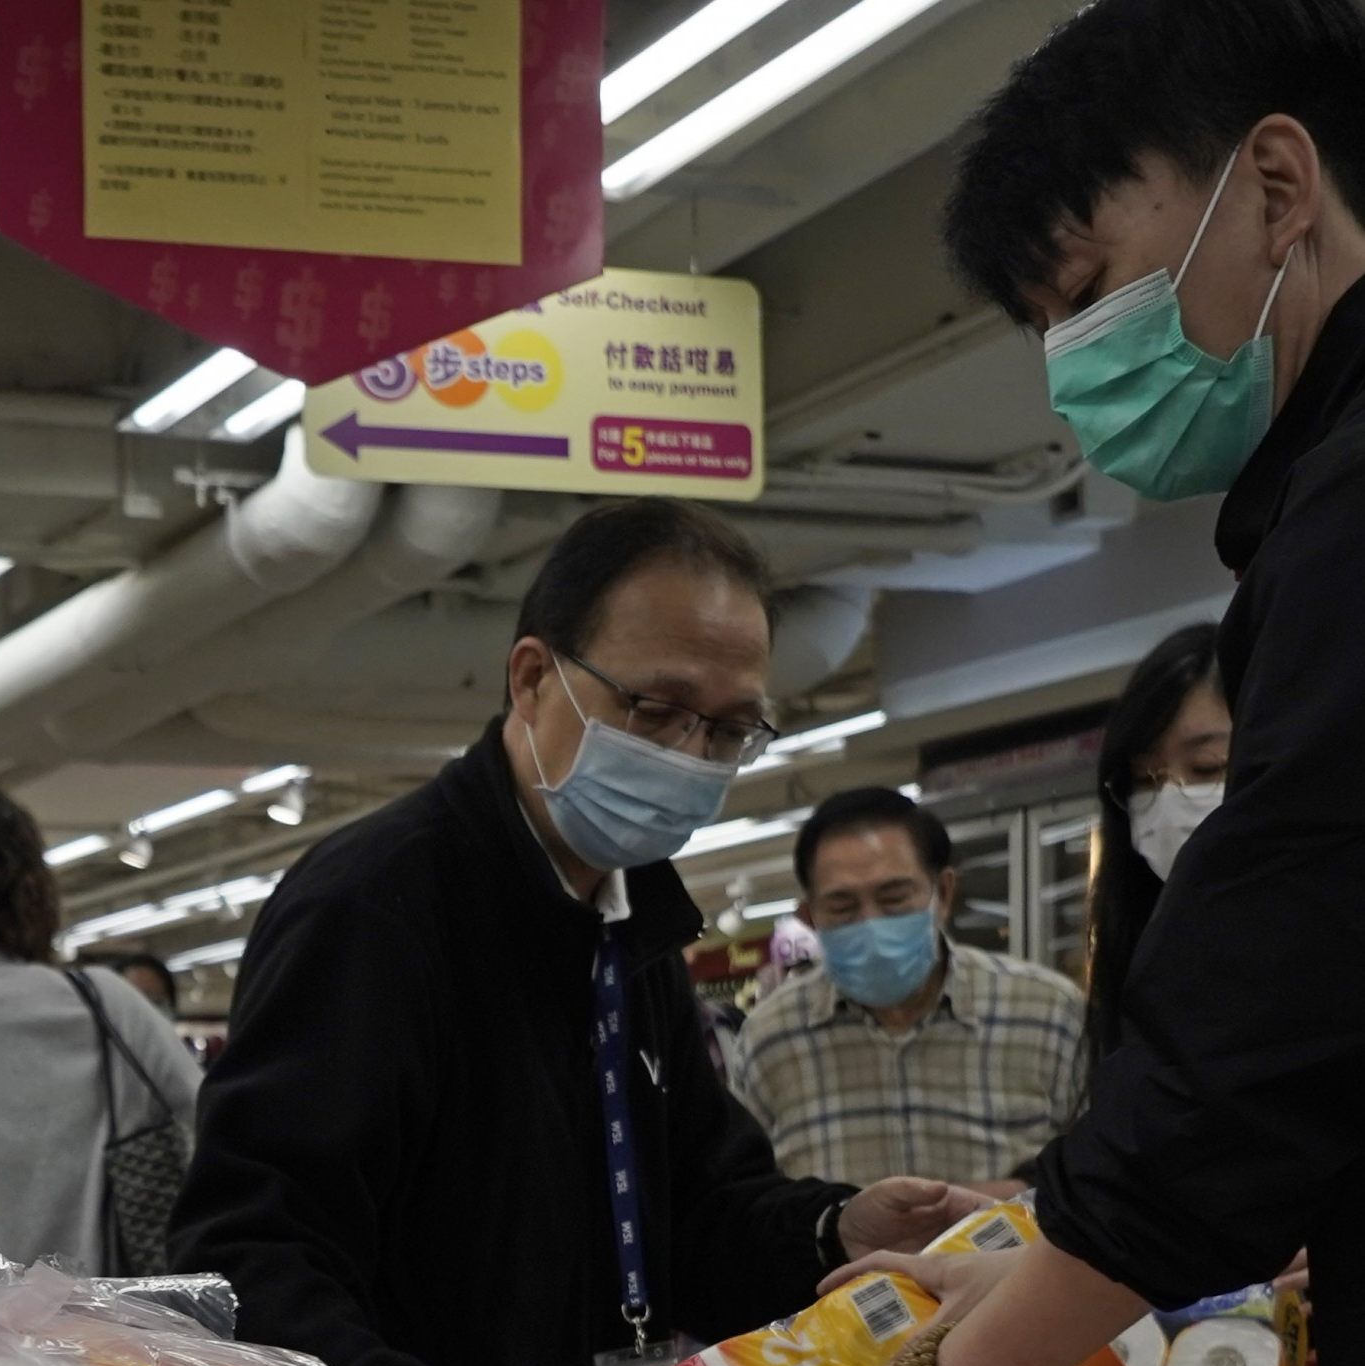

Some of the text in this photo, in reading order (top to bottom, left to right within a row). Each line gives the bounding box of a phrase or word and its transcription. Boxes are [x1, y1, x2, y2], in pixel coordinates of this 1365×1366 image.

[557, 288, 707, 318] Self-Checkout
[466, 356, 545, 389] steps
[607, 376, 737, 399] to easy payment
